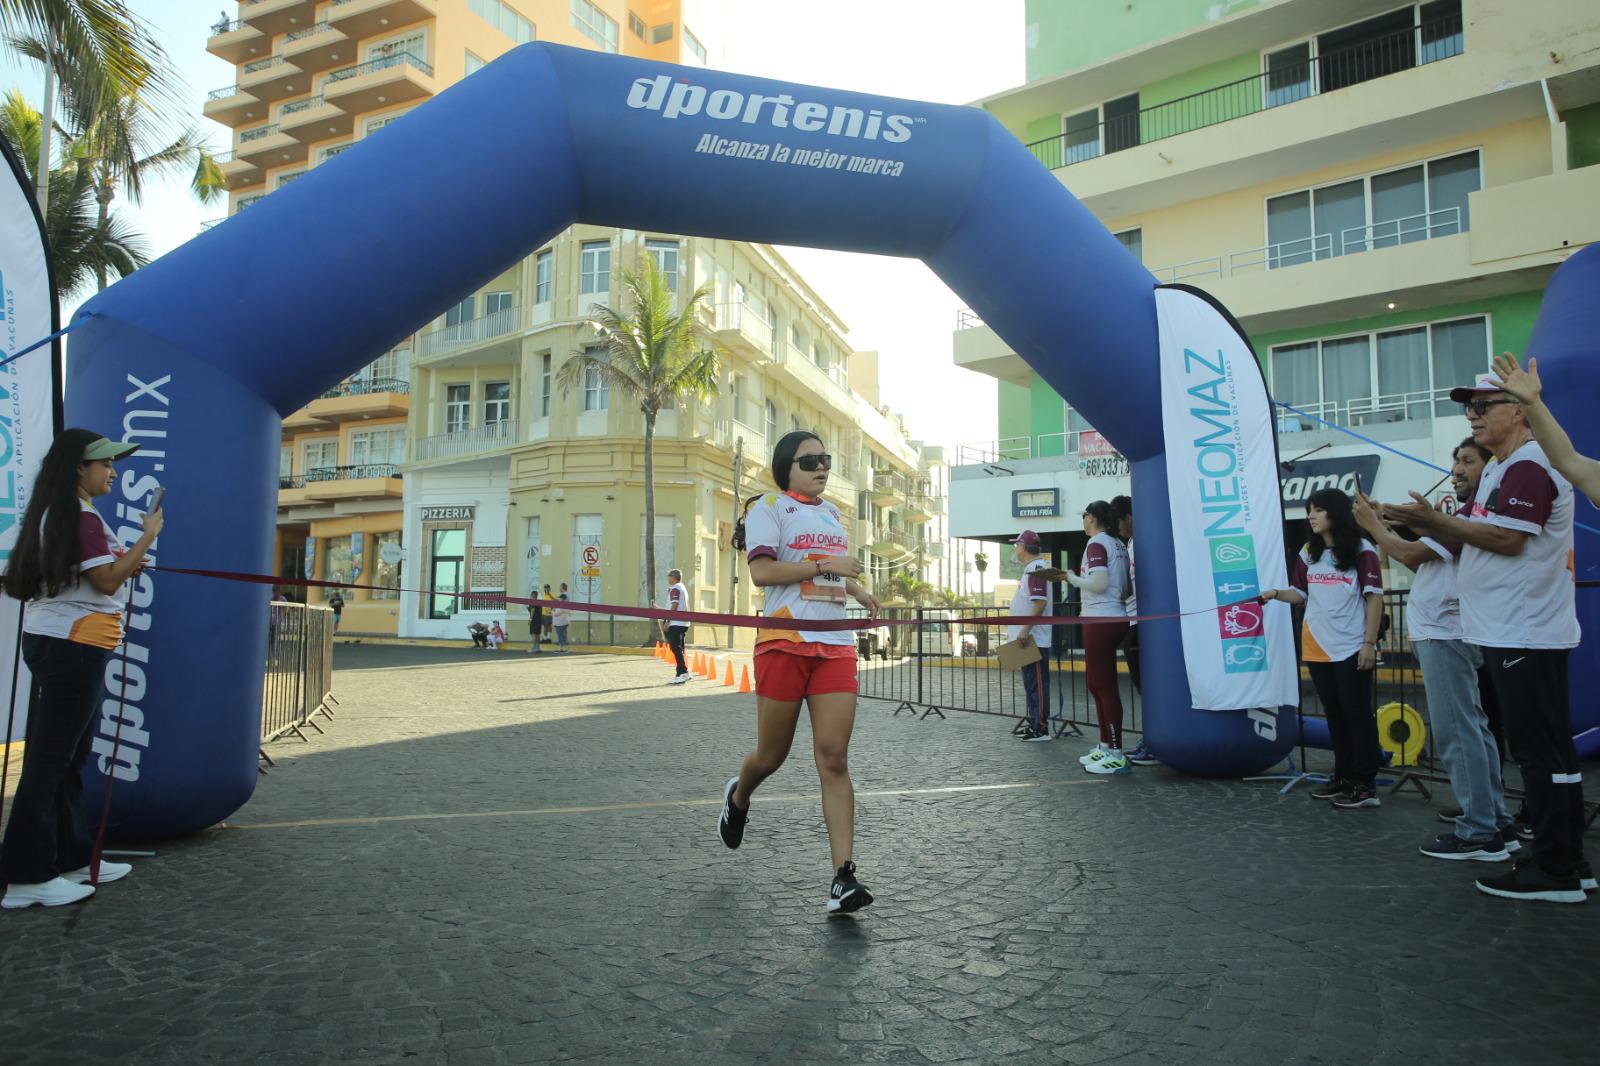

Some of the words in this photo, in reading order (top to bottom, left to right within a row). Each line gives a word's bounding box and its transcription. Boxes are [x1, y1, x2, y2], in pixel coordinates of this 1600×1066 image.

[626, 75, 914, 143] dportenis
[695, 133, 769, 161] Alcanza
[771, 143, 789, 163] la
[794, 148, 850, 171] mejor
[849, 155, 905, 177] marca
[6, 289, 16, 351] VACUNAS
[1225, 360, 1236, 400] VACUNAS
[11, 382, 23, 466] APLICACIÓN
[1231, 404, 1239, 416] DE
[1184, 348, 1245, 537] NEOMAZ
[421, 507, 471, 519] PIZZERIA
[794, 533, 816, 545] IPN
[817, 533, 843, 545] ONCE
